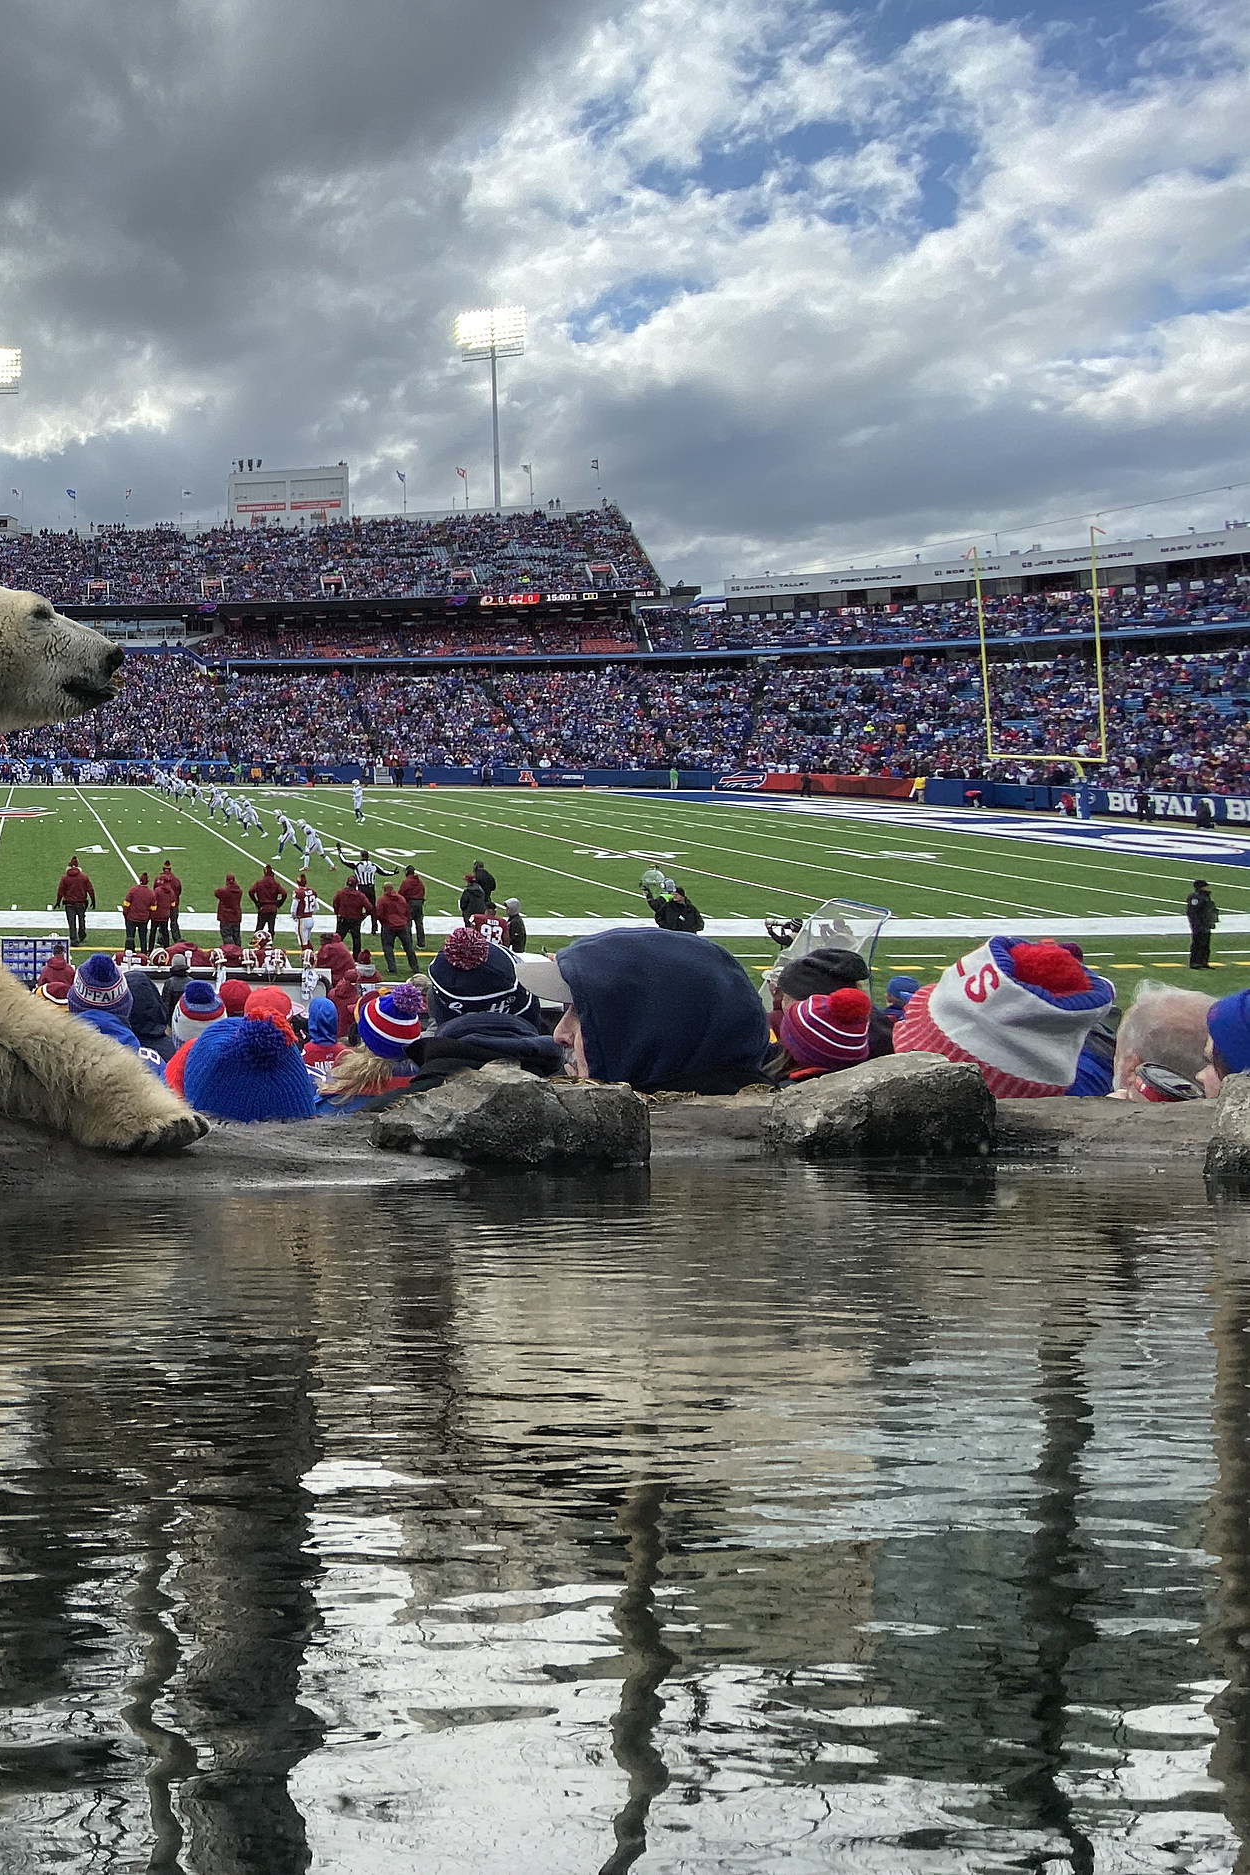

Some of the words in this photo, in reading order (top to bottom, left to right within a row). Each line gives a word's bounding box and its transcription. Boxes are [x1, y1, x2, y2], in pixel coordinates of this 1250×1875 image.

[1196, 541, 1225, 549] LEVY
[546, 593, 571, 602] 15:00
[75, 844, 162, 854] 40
[304, 895, 316, 913] 12
[481, 923, 504, 945] 93
